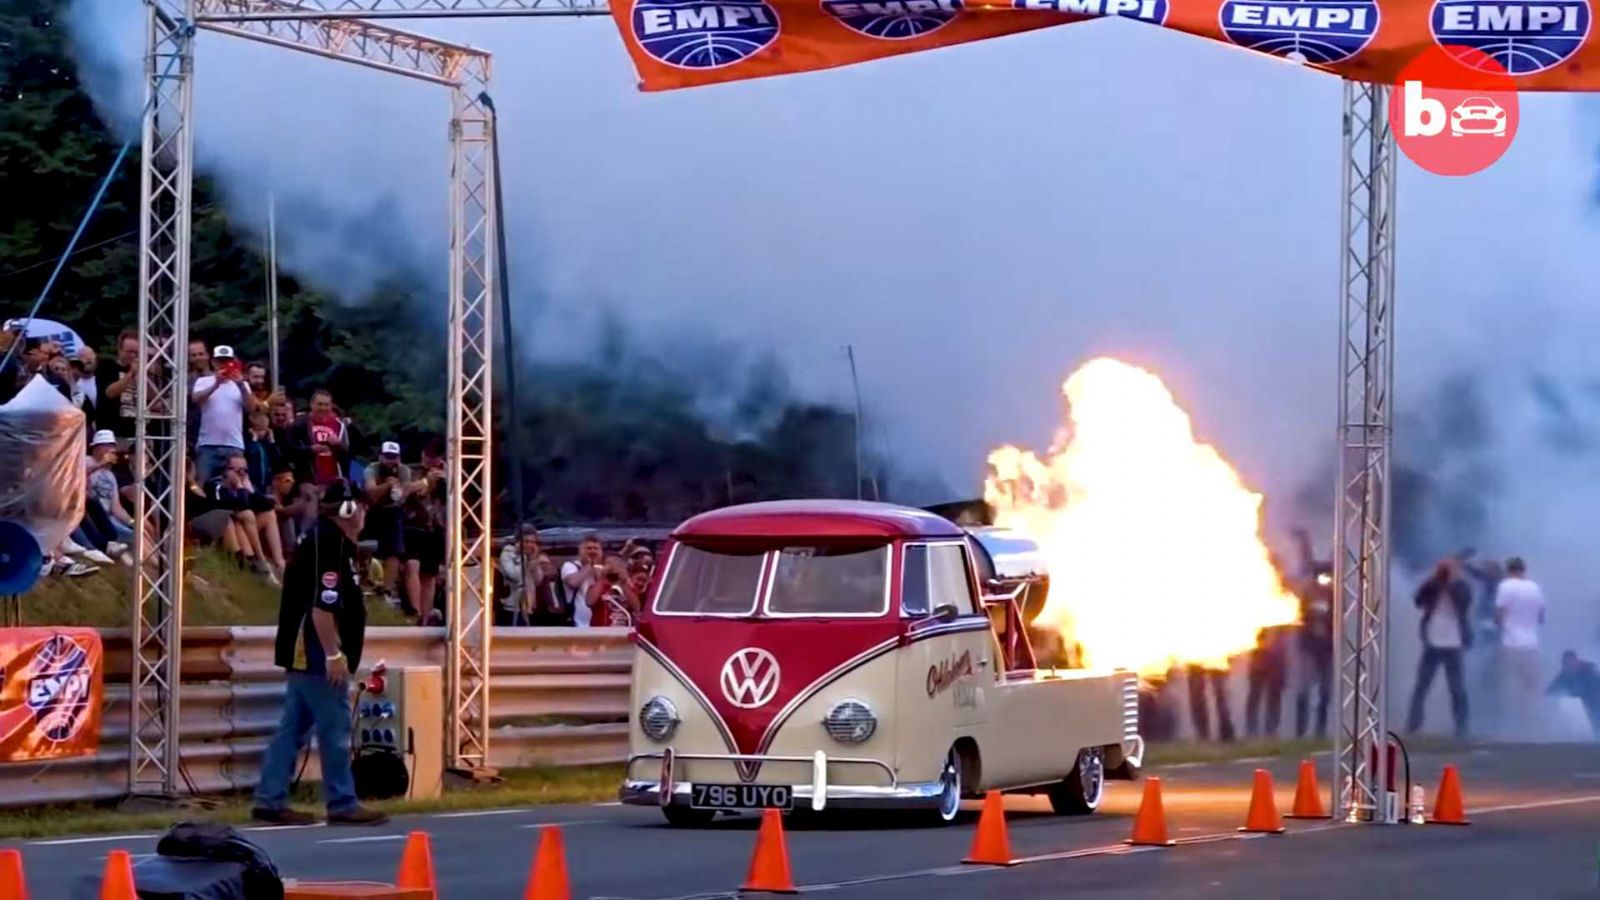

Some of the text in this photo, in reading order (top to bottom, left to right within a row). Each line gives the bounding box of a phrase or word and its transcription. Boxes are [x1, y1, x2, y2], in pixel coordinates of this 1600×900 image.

[642, 6, 770, 35] EMPI
[1231, 4, 1368, 30] EMPI
[1442, 5, 1579, 31] EMPI
[721, 648, 780, 708] VW
[695, 785, 788, 807] 796 UYO
